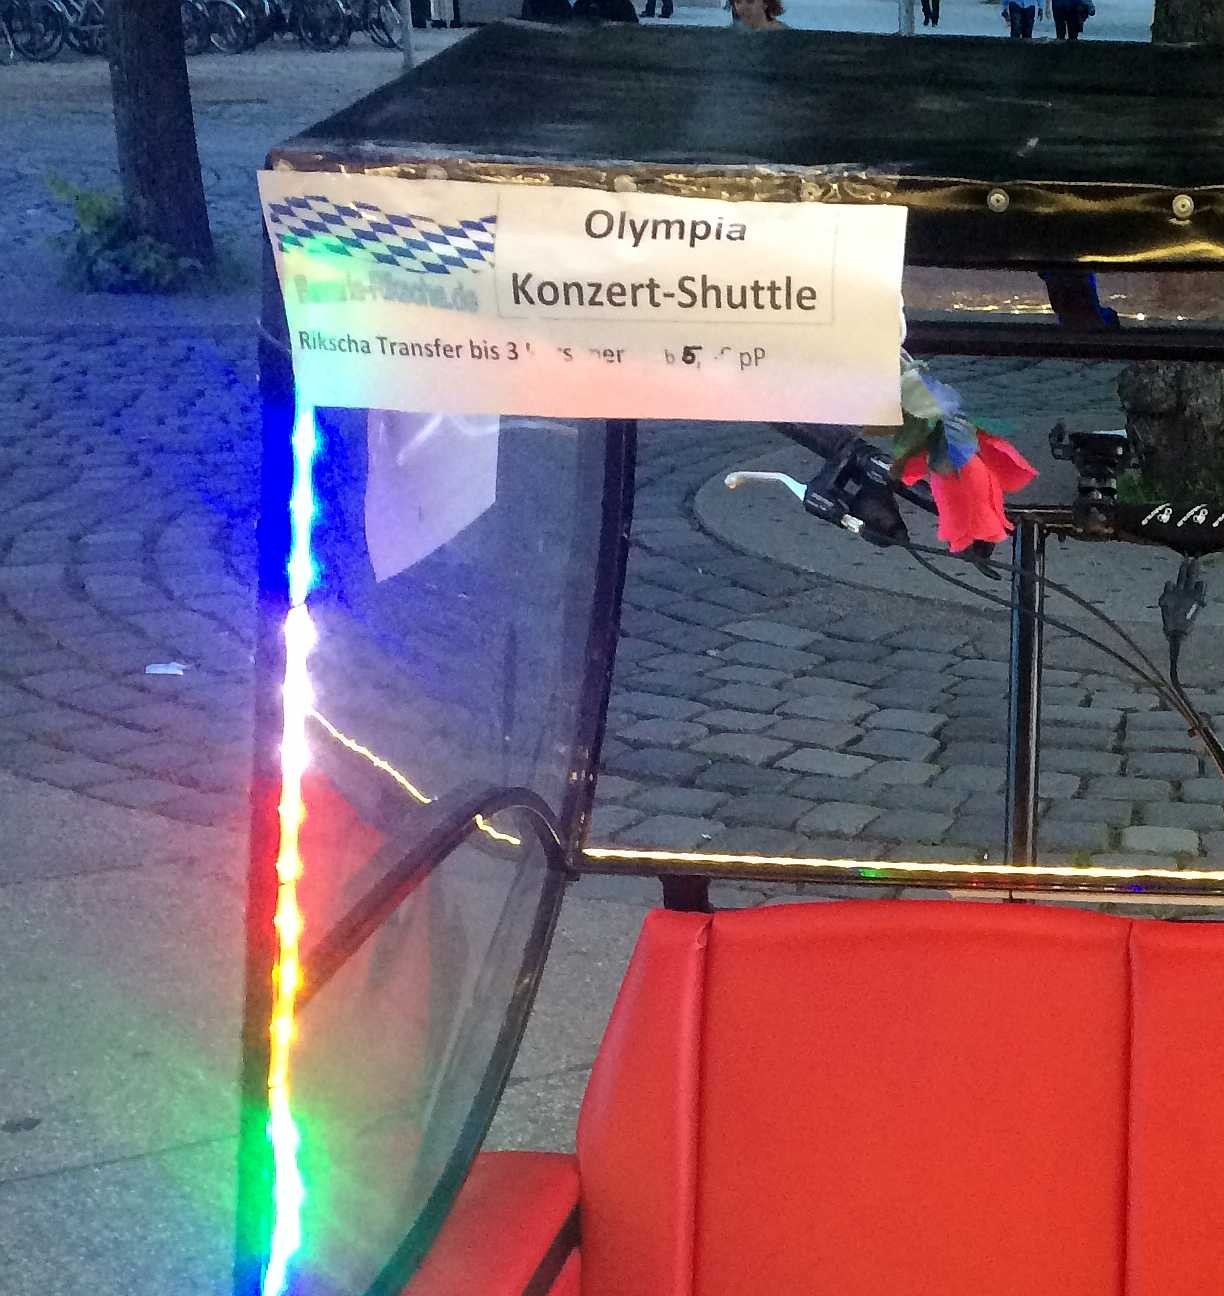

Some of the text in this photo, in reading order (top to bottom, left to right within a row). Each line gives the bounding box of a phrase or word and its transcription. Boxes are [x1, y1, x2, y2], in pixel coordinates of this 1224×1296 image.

[584, 209, 747, 248] Olympia
[511, 272, 818, 311] Konzert-Shuttle
[298, 330, 371, 354] Rikscha
[376, 336, 463, 360] Transfer
[469, 339, 500, 361] bis
[506, 341, 519, 361] 3
